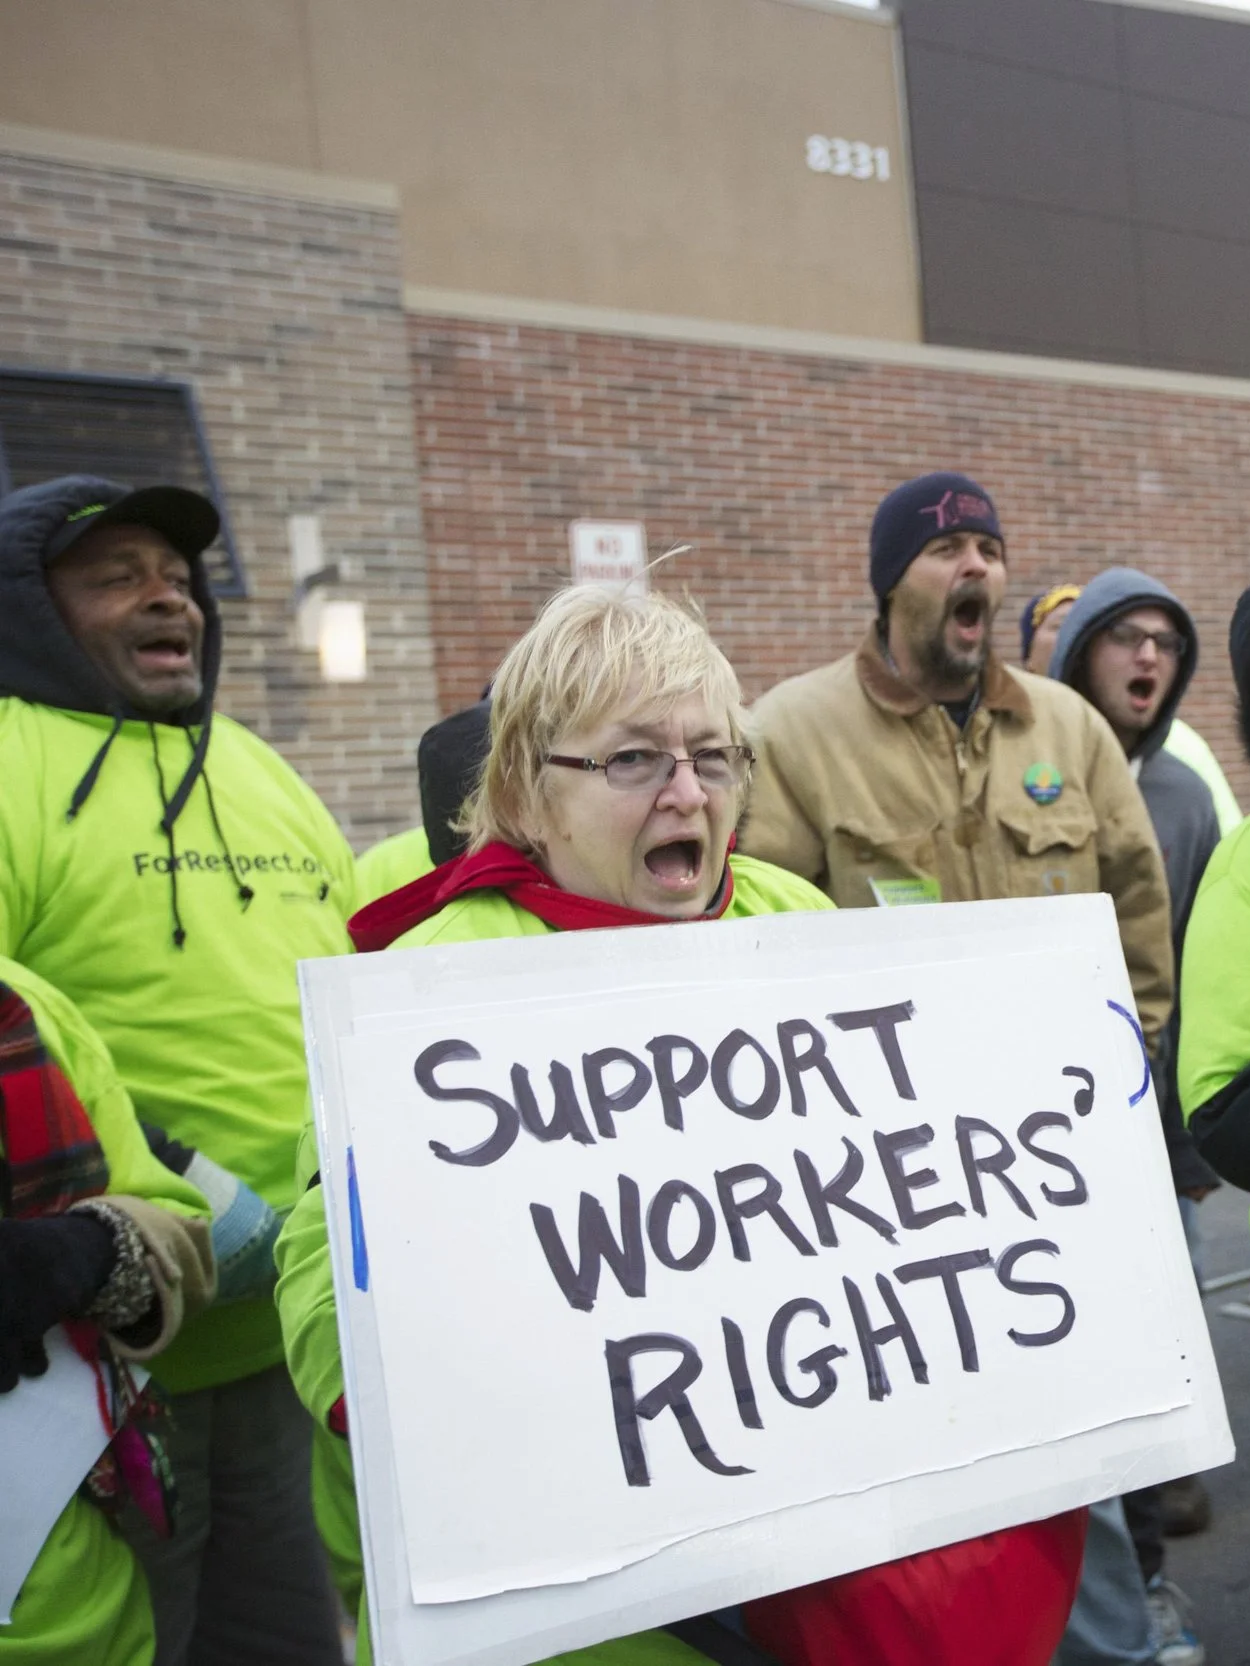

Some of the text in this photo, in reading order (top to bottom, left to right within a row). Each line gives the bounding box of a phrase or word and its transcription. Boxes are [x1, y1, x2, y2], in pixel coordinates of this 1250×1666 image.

[804, 134, 890, 181] 8331
[414, 999, 917, 1167] SUPPORT
[604, 1238, 1076, 1488] RIGHTS
